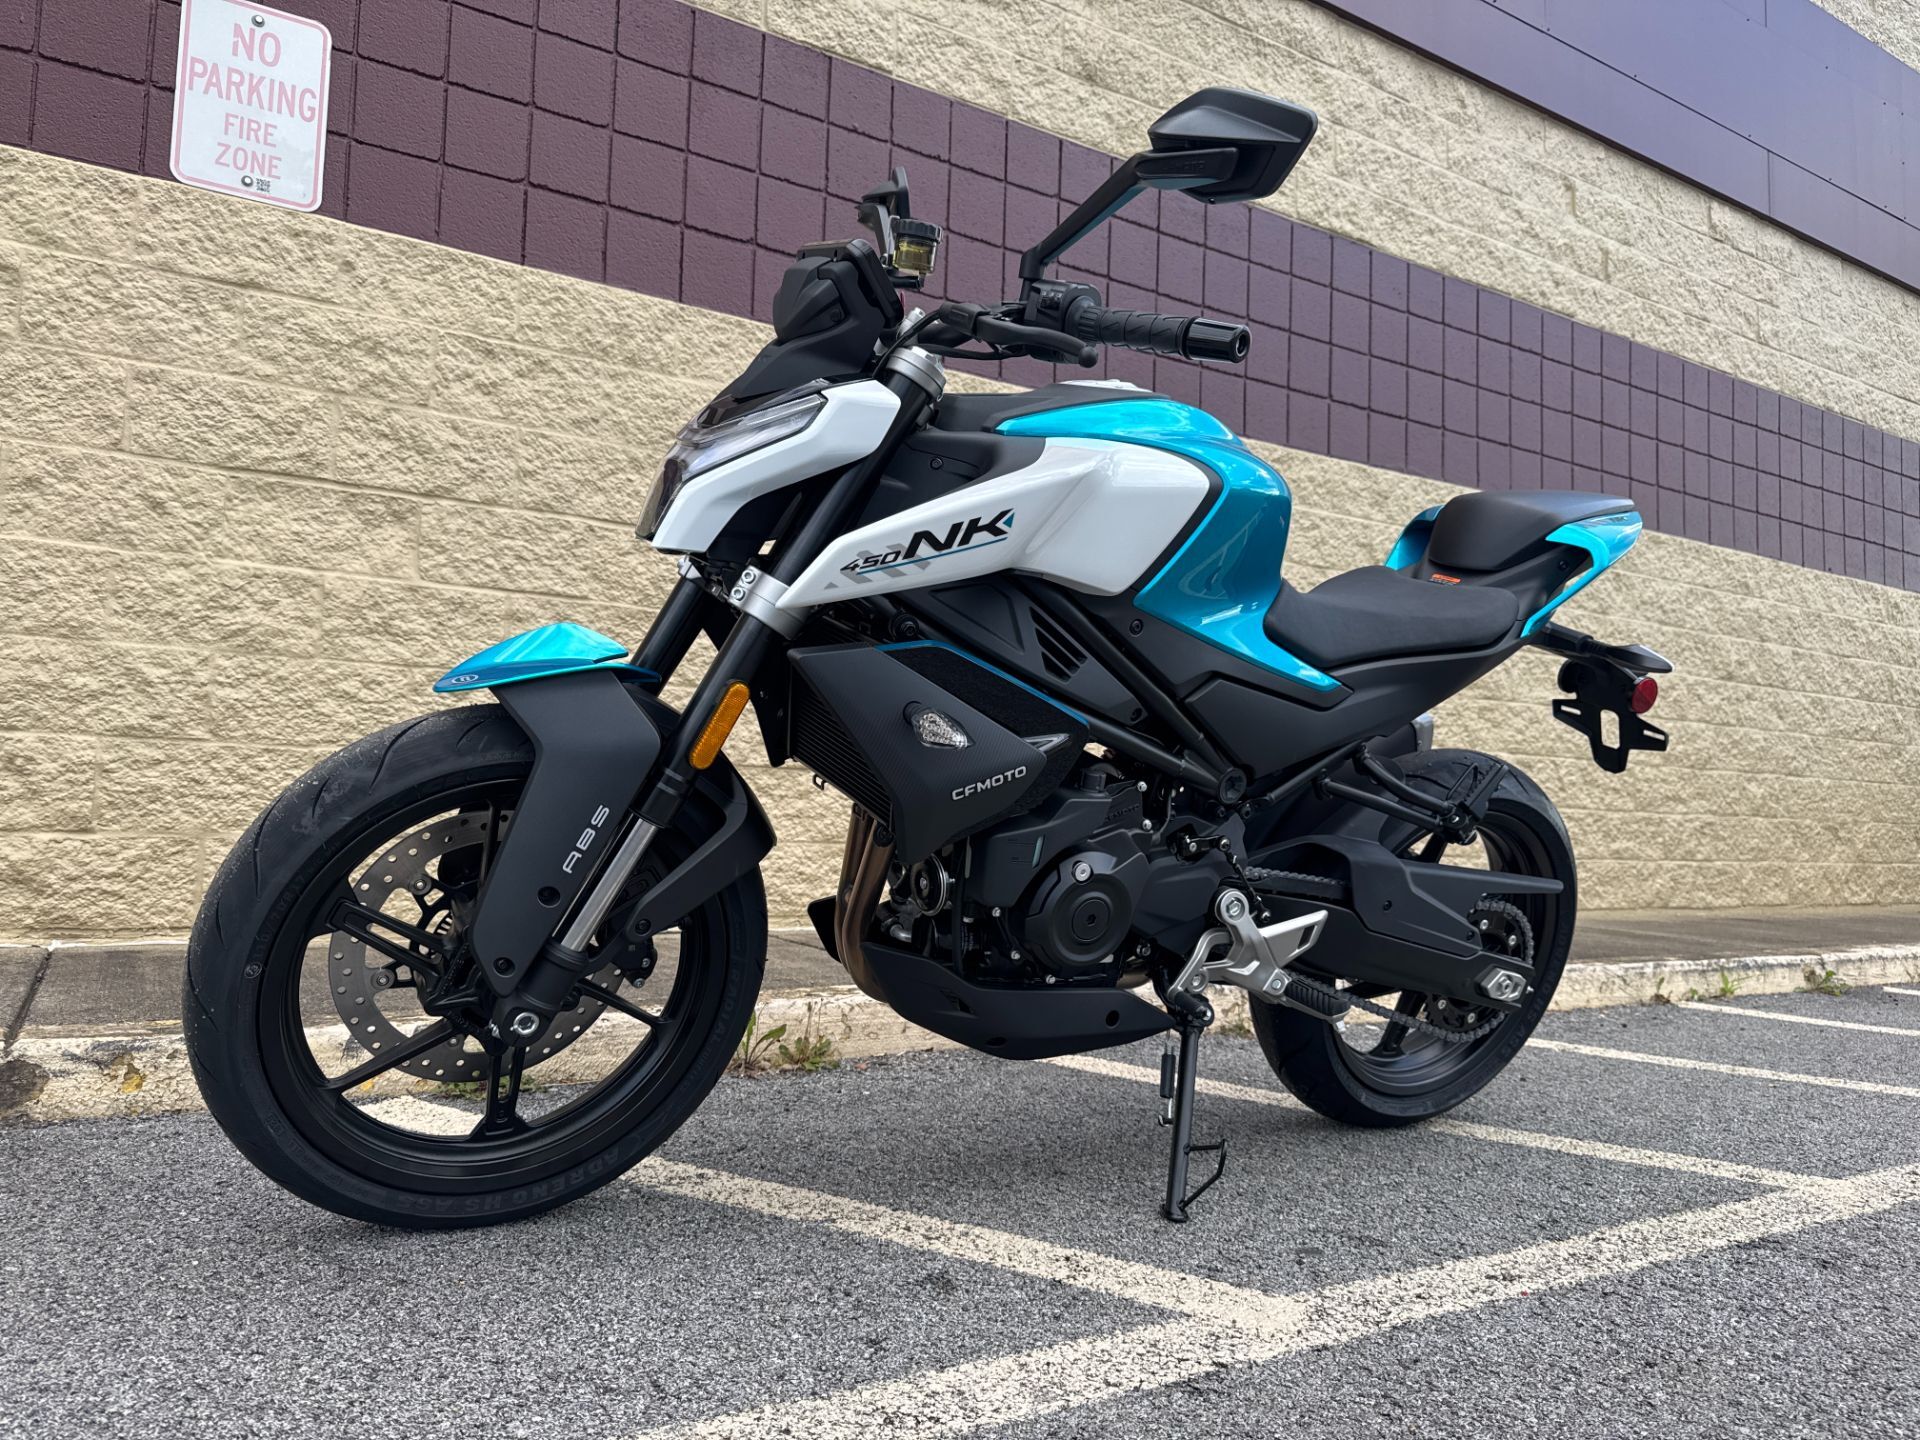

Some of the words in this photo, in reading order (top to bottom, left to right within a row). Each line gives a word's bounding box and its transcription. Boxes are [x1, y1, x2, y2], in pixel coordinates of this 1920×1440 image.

[231, 22, 282, 68] NO
[187, 56, 317, 123] PARKING
[223, 112, 278, 148] FIRE
[214, 142, 282, 180] ZONE
[951, 765, 1027, 801] CFMOTO
[562, 804, 610, 874] ABS
